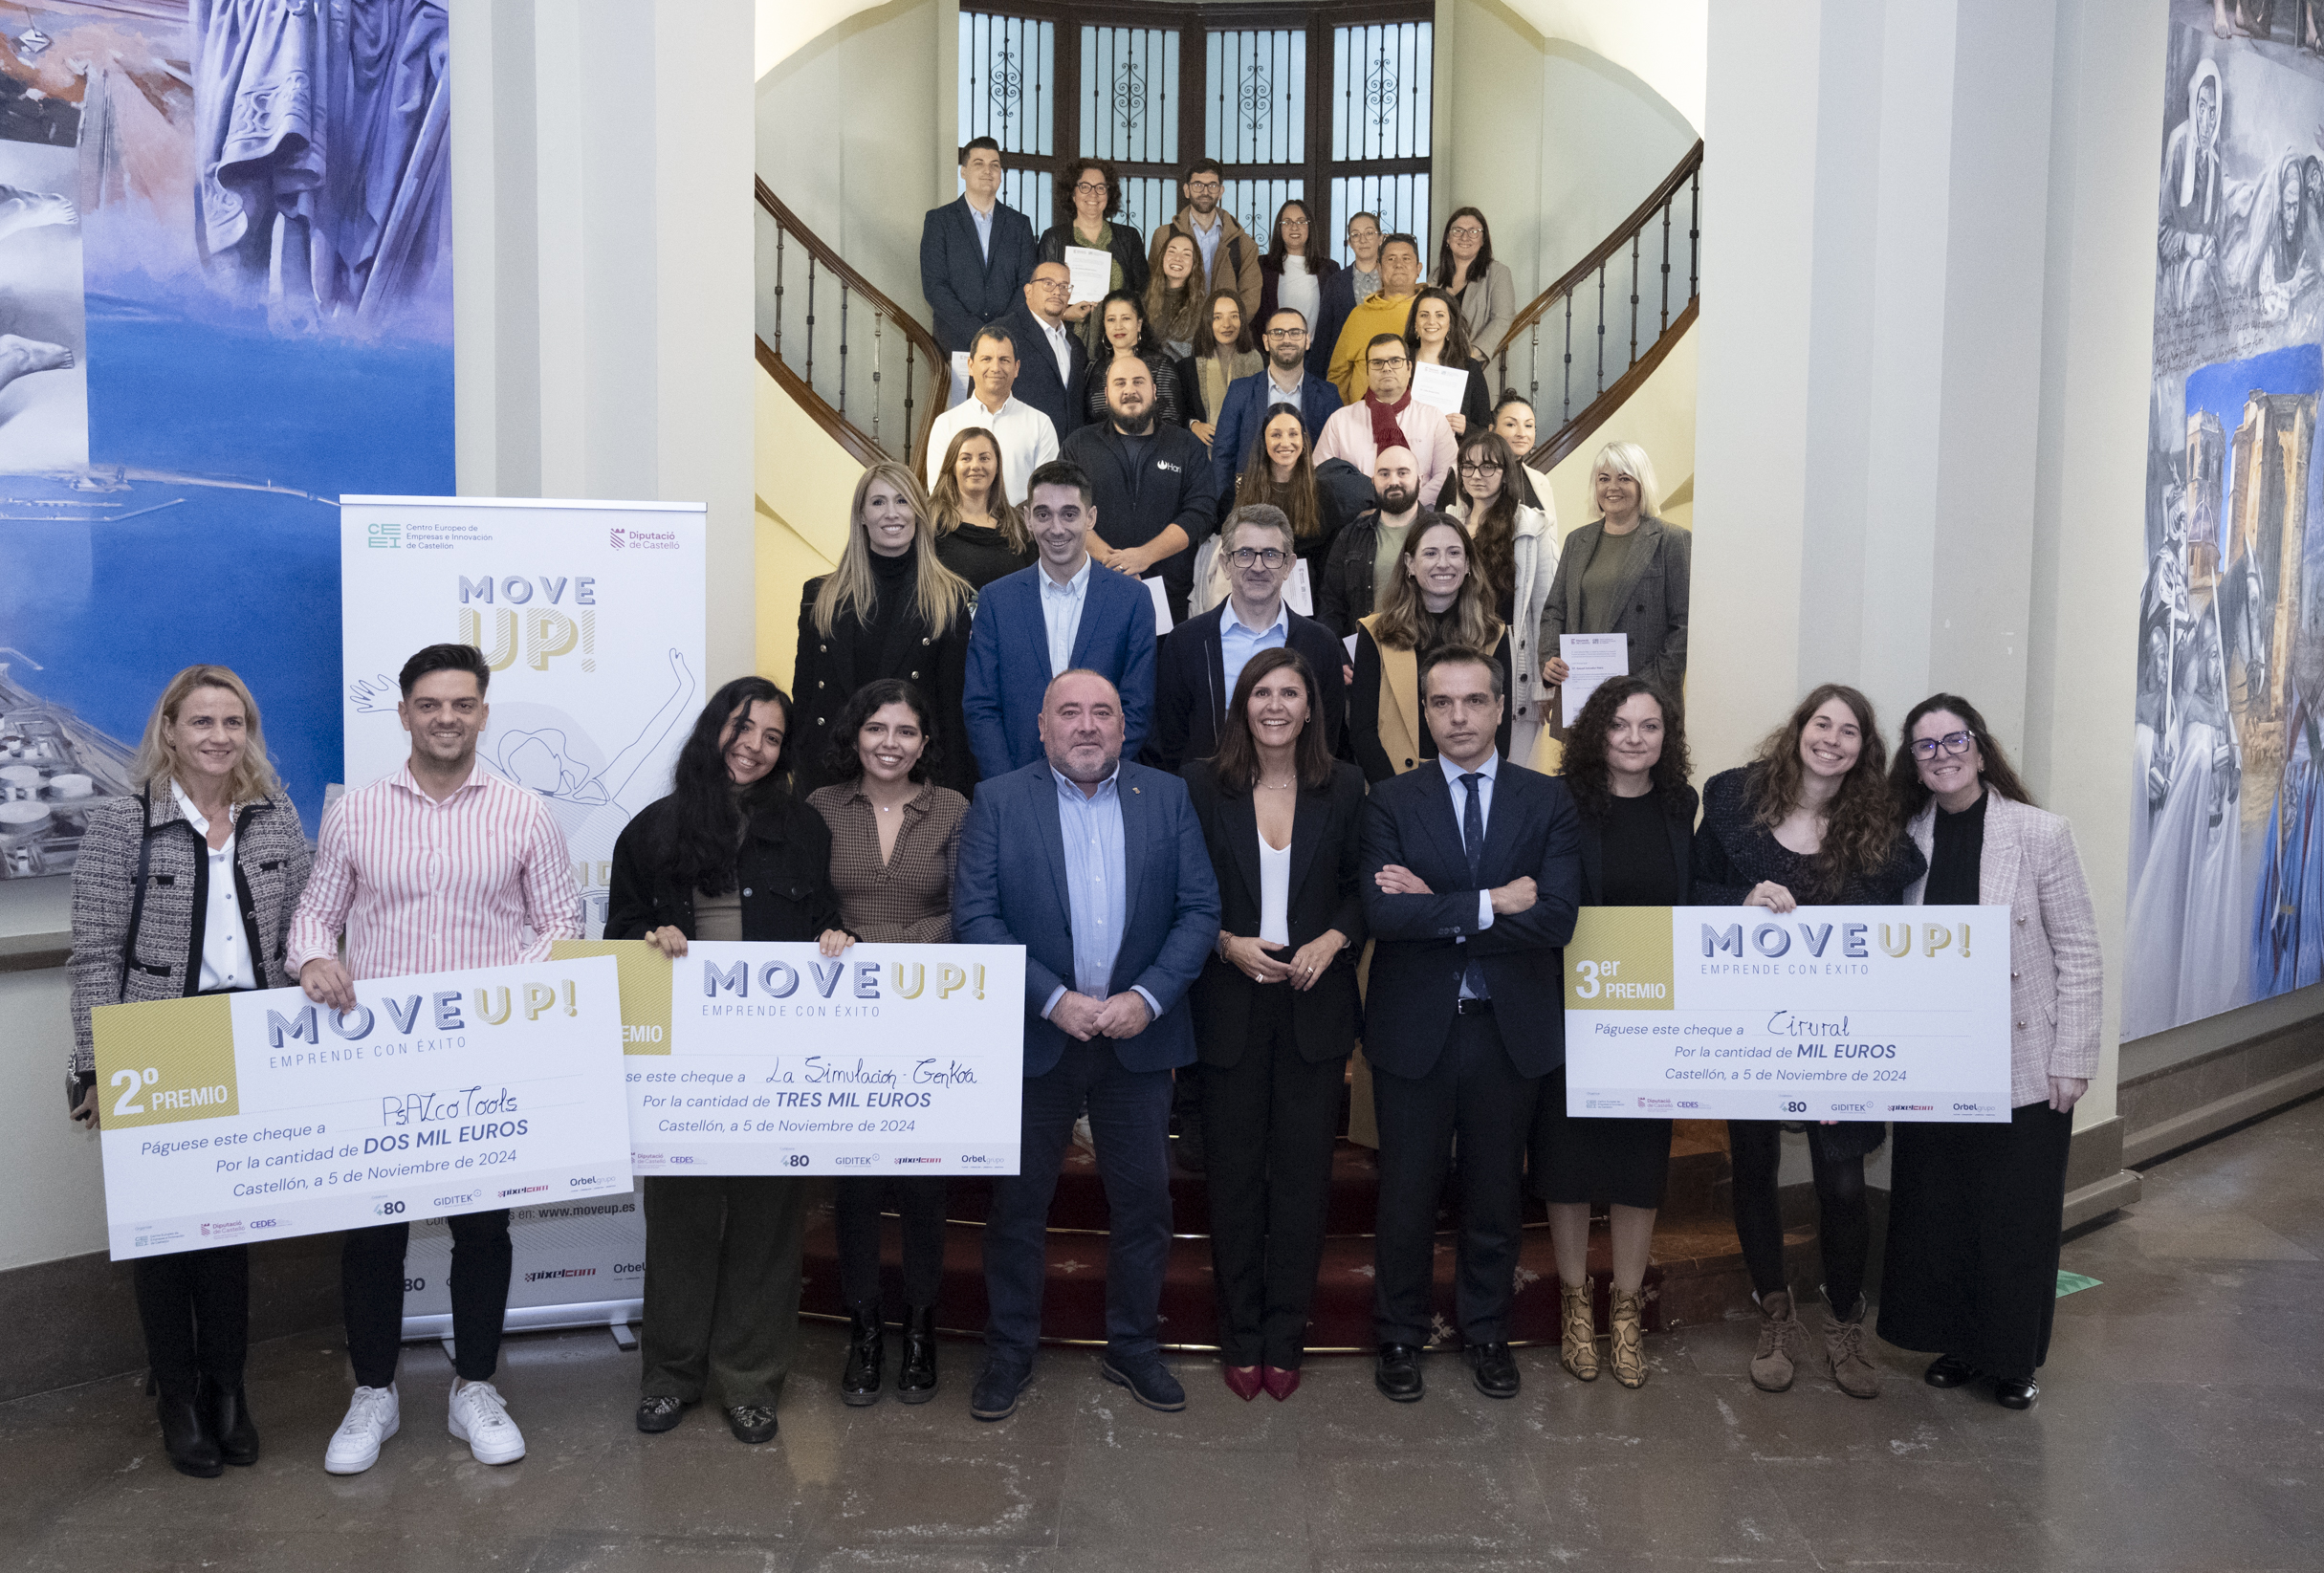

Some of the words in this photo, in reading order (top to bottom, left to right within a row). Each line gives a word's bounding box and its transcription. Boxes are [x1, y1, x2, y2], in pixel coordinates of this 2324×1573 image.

[435, 524, 466, 533] Europeo
[629, 531, 675, 541] Diputació
[406, 533, 444, 541] Empresas
[629, 540, 642, 549] de
[643, 540, 680, 550] Castelló
[458, 574, 596, 605] MOVE
[458, 607, 597, 673] UP!
[1701, 965, 1781, 975] EMPRENDE
[1788, 965, 1818, 975] CON
[1826, 962, 1870, 975] ÉXITO
[1606, 983, 1666, 999] PREMIO
[702, 1004, 787, 1016] EMPRENDE
[796, 1005, 826, 1017] CON
[835, 1003, 881, 1017] ÉXITO
[622, 1025, 663, 1043] EMIO
[1594, 1023, 1649, 1038] Páguese
[1652, 1024, 1680, 1036] este
[1683, 1024, 1733, 1038] cheque
[1736, 1027, 1744, 1036] a
[270, 1048, 365, 1069] EMPRENDE
[374, 1043, 408, 1058] CON
[417, 1037, 468, 1053] ÉXITO
[1675, 1046, 1697, 1058] Por
[1699, 1046, 1711, 1058] la
[1714, 1046, 1772, 1058] cantidad
[1775, 1047, 1793, 1059] de
[1796, 1044, 1828, 1059] MIL
[1833, 1044, 1896, 1059] EUROS
[646, 1071, 676, 1082] este
[680, 1070, 734, 1085] cheque
[737, 1073, 746, 1082] a
[766, 1057, 795, 1083] La
[1665, 1068, 1727, 1081] Castellón,
[1731, 1072, 1739, 1081] a
[1743, 1069, 1752, 1081] 5
[1755, 1069, 1772, 1081] de
[1776, 1069, 1848, 1081] Noviembre
[1851, 1069, 1869, 1081] de
[1873, 1070, 1907, 1081] 2024
[110, 1067, 159, 1116] 2º
[151, 1084, 228, 1111] PREMIO
[643, 1095, 667, 1107] Por
[670, 1095, 682, 1107] la
[686, 1095, 750, 1107] cantidad
[752, 1096, 771, 1107] de
[776, 1092, 822, 1107] TRES
[827, 1092, 861, 1107] MIL
[866, 1092, 932, 1107] EUROS
[1831, 1103, 1866, 1112] GIDITEK
[658, 1120, 726, 1133] Castellón,
[730, 1123, 738, 1132] a
[743, 1120, 753, 1132] 5
[756, 1120, 775, 1132] de
[778, 1120, 854, 1132] Noviembre
[858, 1120, 876, 1132] de
[880, 1120, 916, 1132] 2024
[142, 1137, 209, 1157] Páguese
[213, 1133, 249, 1147] este
[252, 1125, 313, 1142] cheque
[317, 1124, 326, 1134] a
[216, 1160, 243, 1173] Por
[247, 1156, 260, 1169] la
[265, 1147, 335, 1167] cantidad
[339, 1145, 360, 1158] de
[363, 1133, 410, 1155] DOS
[416, 1128, 452, 1148] MIL
[458, 1119, 529, 1143] EUROS
[669, 1156, 694, 1165] CEDES
[835, 1156, 872, 1166] GIDITEK
[232, 1176, 310, 1197] Castellón,
[314, 1175, 323, 1187] a
[328, 1171, 339, 1186] 5
[342, 1169, 363, 1183] de
[367, 1160, 450, 1181] Noviembre
[454, 1155, 474, 1169] de
[478, 1149, 517, 1166] 2024
[433, 1193, 473, 1207] GIDITEK
[518, 1209, 537, 1221] en:
[538, 1202, 636, 1219] www.moveup.es
[212, 1220, 243, 1231] Diputació
[221, 1225, 246, 1234] Castelló
[250, 1218, 277, 1230] CEDES
[529, 1267, 597, 1282] pixelcom
[404, 1277, 426, 1292] 80
